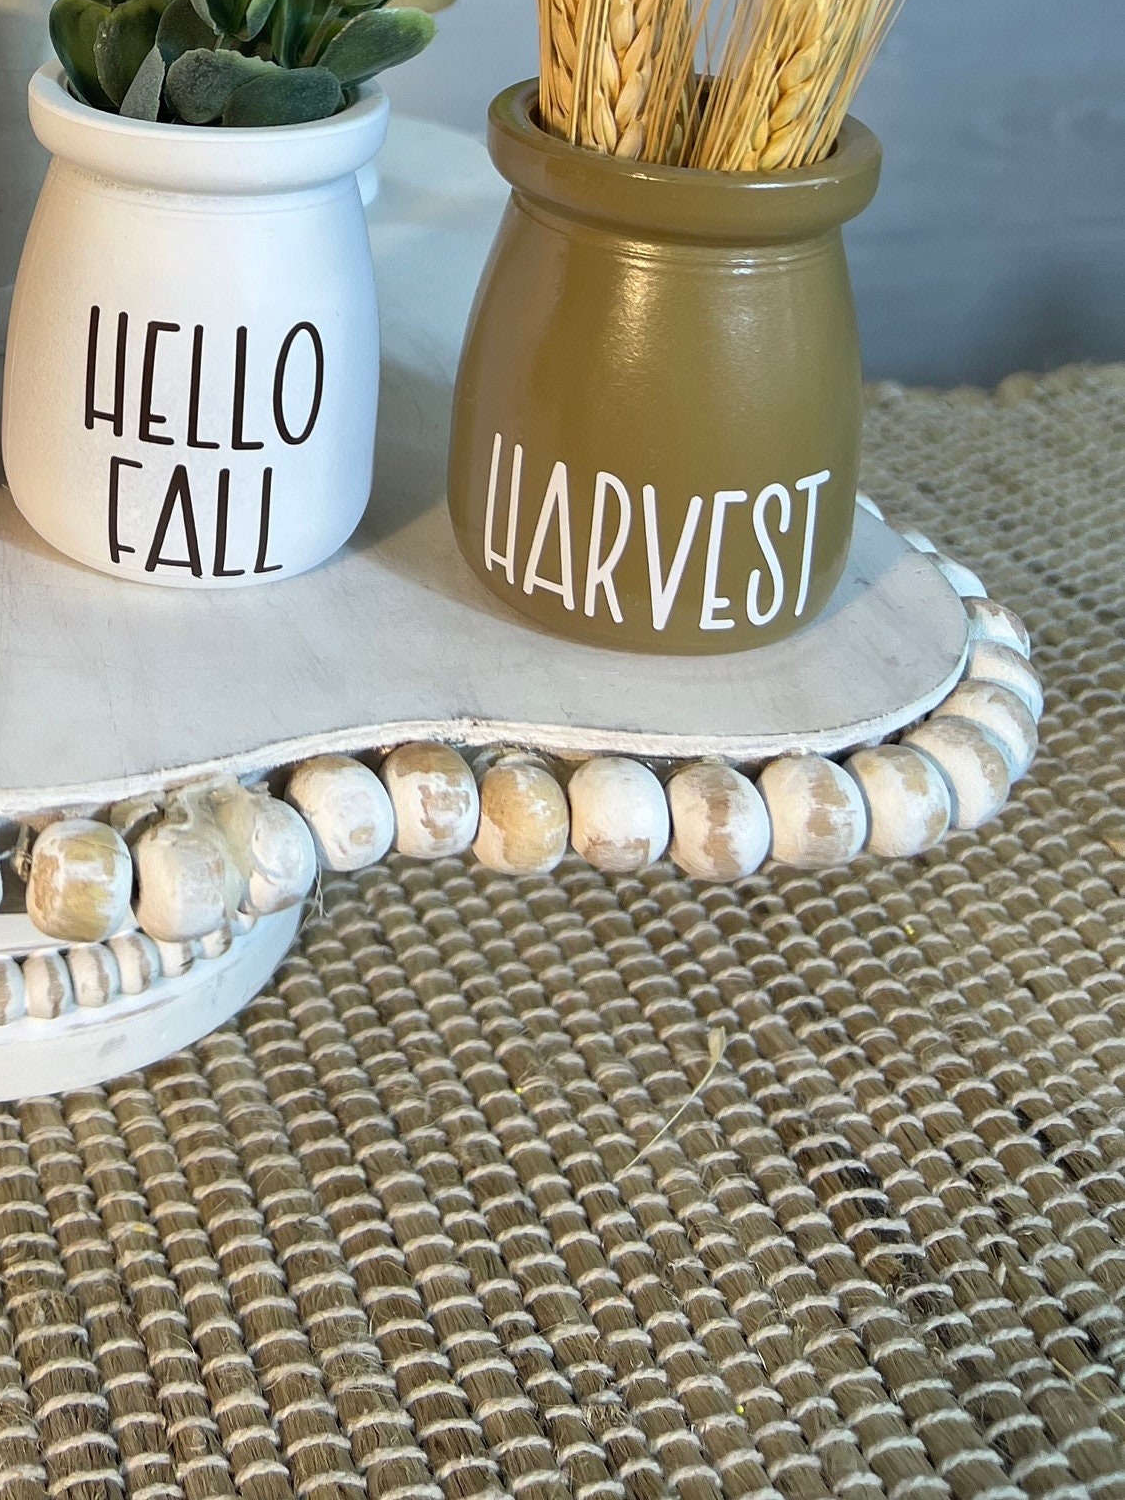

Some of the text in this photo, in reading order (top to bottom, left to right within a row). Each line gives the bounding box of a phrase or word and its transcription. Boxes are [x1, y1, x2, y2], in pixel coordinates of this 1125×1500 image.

[85, 305, 324, 451] HELLO
[109, 456, 283, 579] FALL
[484, 432, 831, 631] HARVEST
